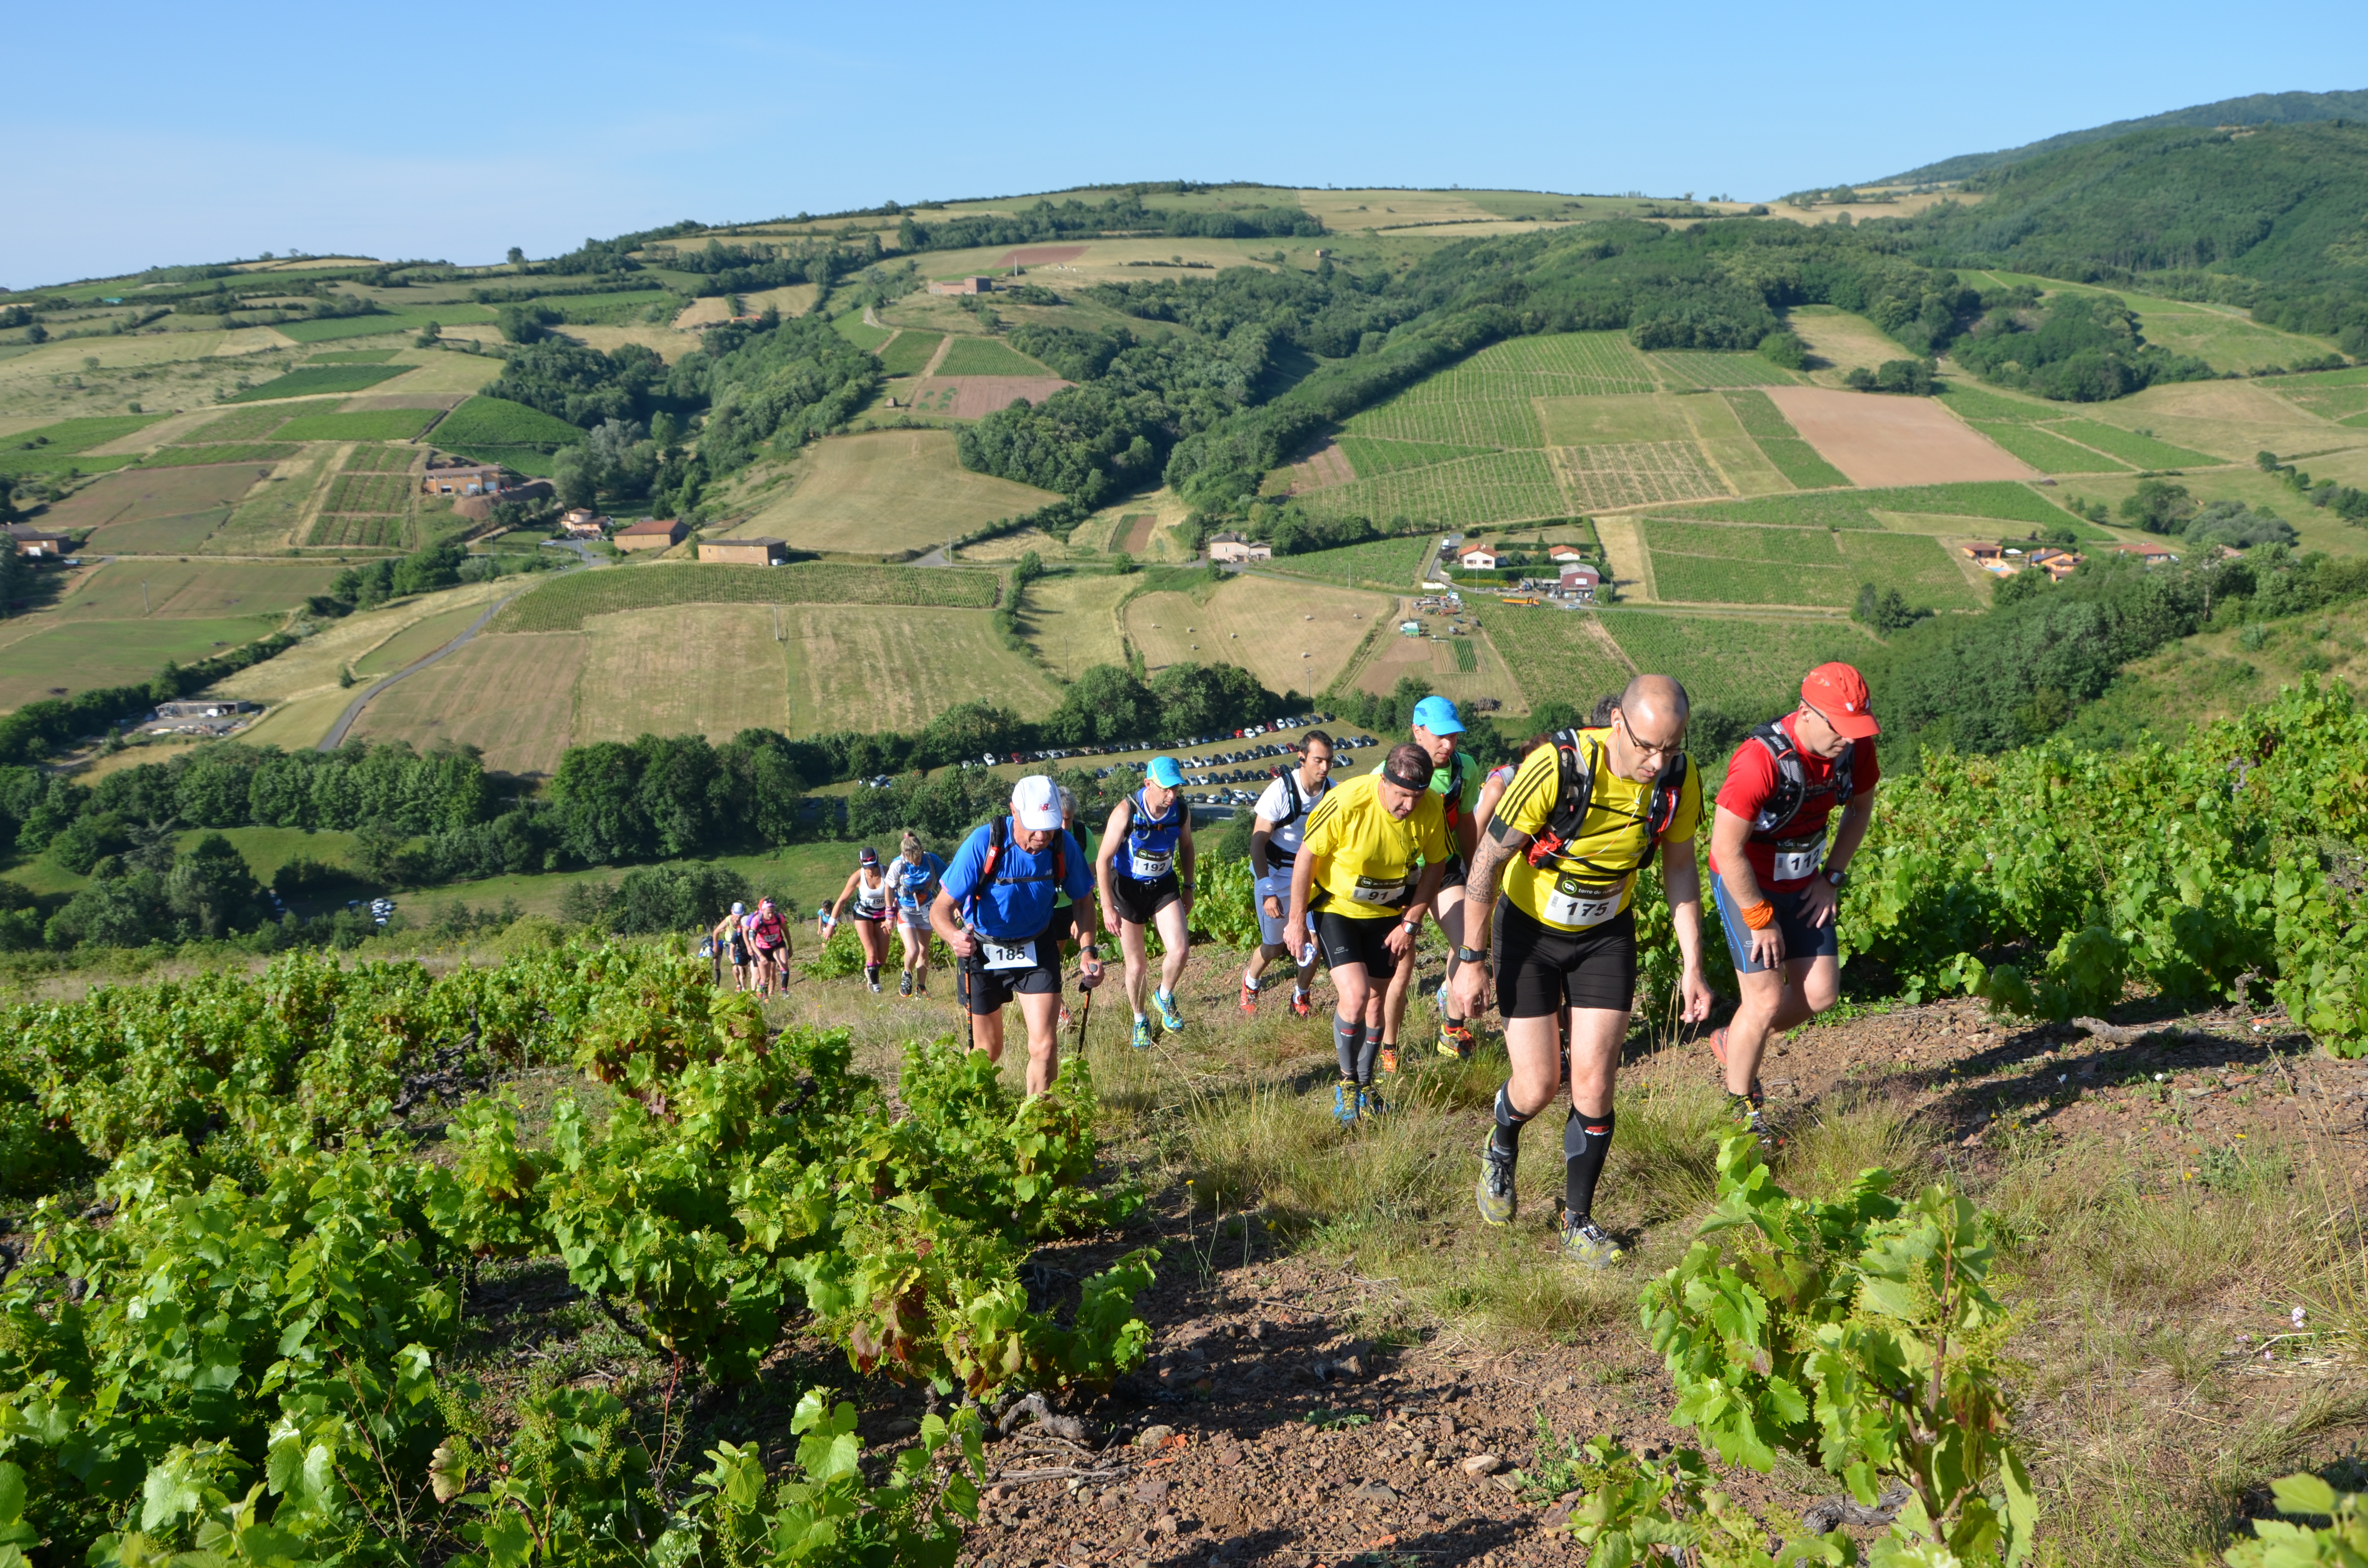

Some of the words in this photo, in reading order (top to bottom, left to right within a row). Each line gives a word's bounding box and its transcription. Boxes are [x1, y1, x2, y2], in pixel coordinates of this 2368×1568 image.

[1791, 848, 1820, 870] 112
[1143, 862, 1166, 872] 192
[1602, 885, 1621, 894] running
[1368, 891, 1389, 901] 91
[1566, 901, 1610, 917] 175
[996, 946, 1025, 961] 185
